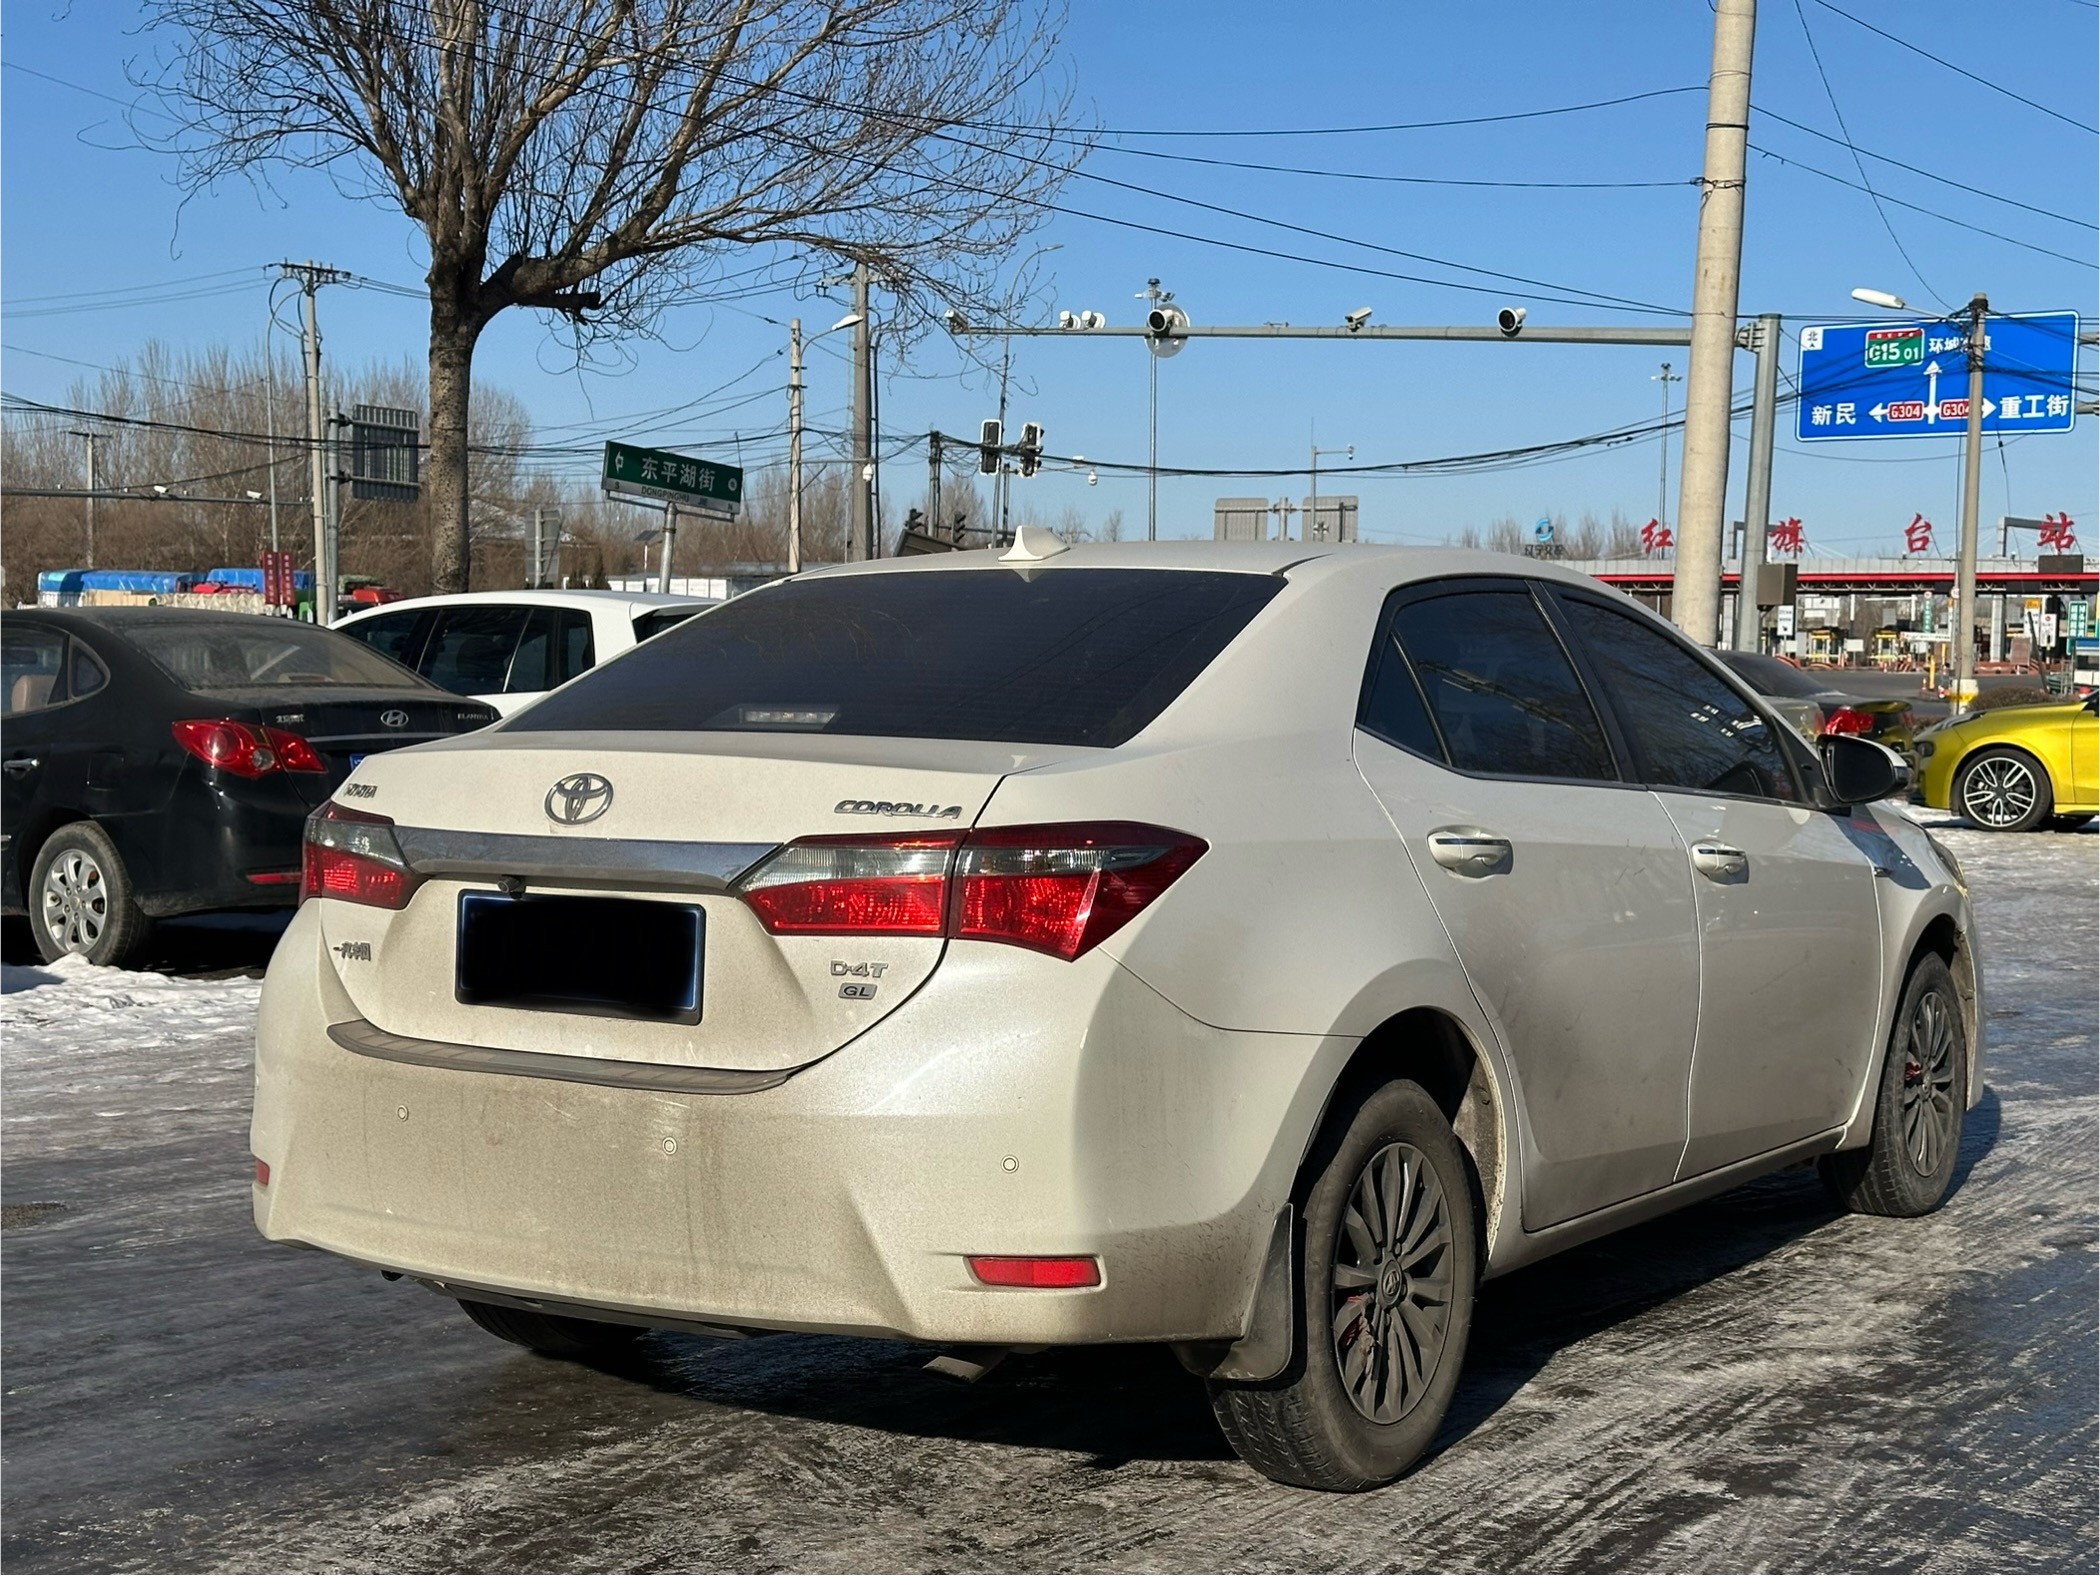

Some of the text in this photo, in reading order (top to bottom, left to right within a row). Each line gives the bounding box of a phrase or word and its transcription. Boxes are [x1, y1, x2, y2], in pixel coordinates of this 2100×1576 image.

[1869, 343, 1919, 361] G15 01
[1811, 402, 1856, 426] 新民
[1890, 405, 1921, 418] G304
[1998, 394, 2070, 419] 重工街
[640, 456, 716, 492] 东平湖街
[834, 799, 962, 820] COROLLA
[843, 985, 870, 997] GL
